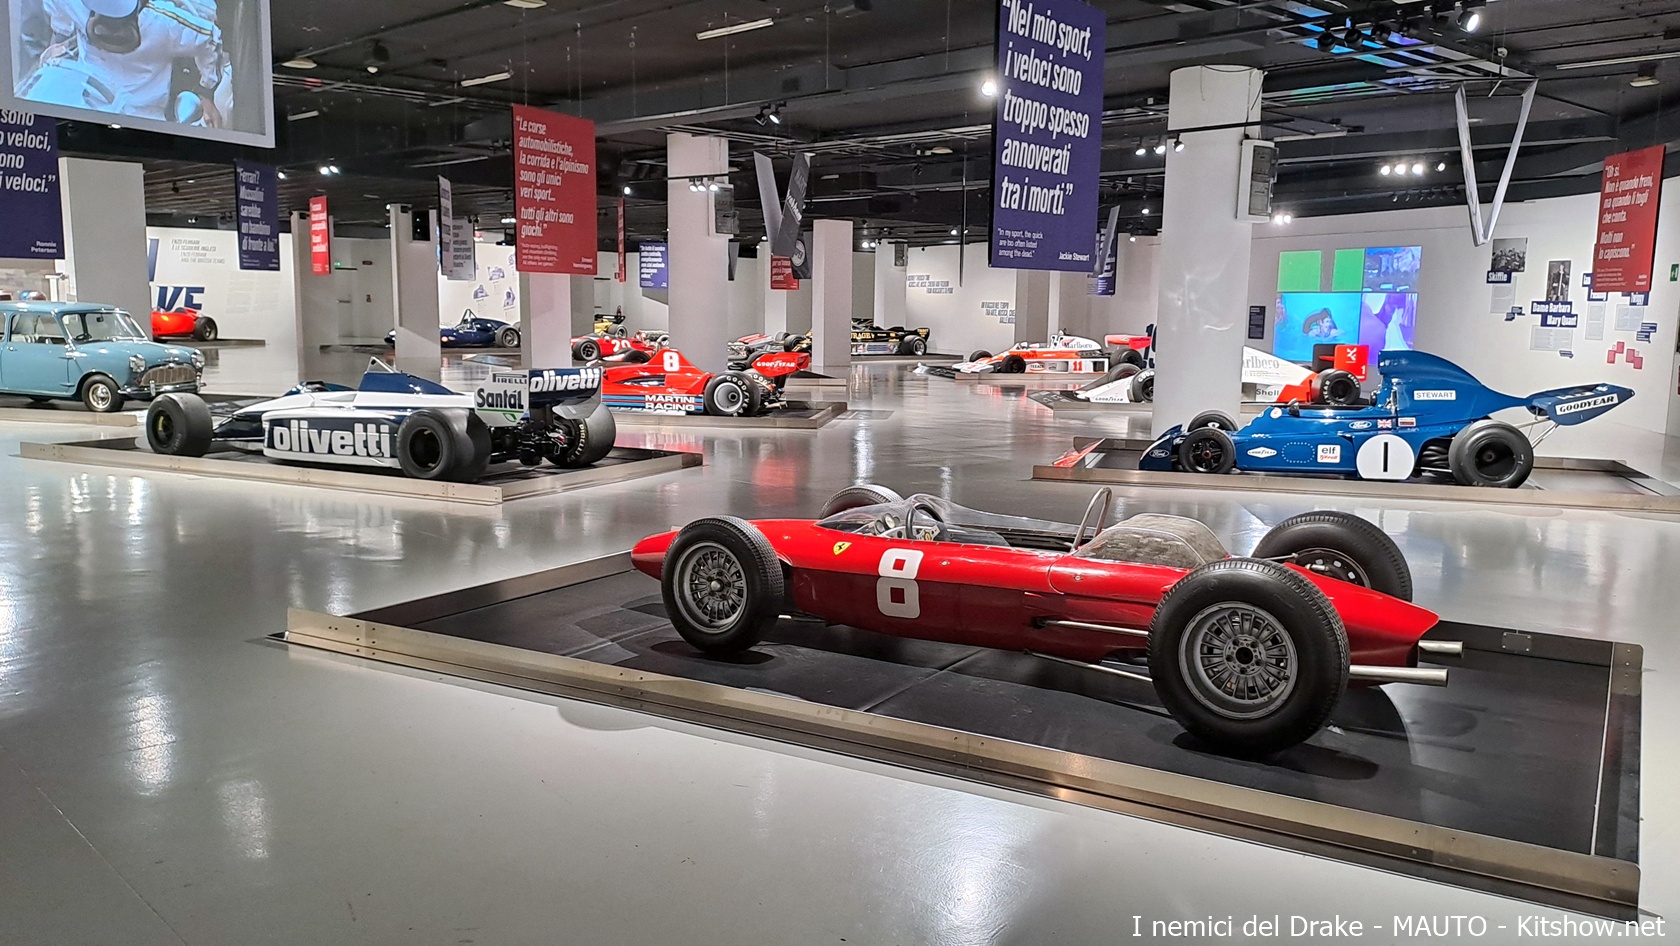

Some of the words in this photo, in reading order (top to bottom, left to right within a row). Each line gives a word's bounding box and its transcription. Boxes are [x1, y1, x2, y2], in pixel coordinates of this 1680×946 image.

[1032, 10, 1057, 46] mio
[1057, 22, 1091, 61] sport,
[1005, 41, 1013, 76] i
[1014, 48, 1053, 88] veloci
[1052, 64, 1082, 96] sono
[0, 110, 34, 126] sono
[1004, 88, 1048, 134] troppo
[1048, 106, 1090, 139] spesso
[528, 121, 547, 135] corse
[7, 130, 51, 152] veloci,
[519, 136, 573, 157] automobilistiche,
[519, 151, 526, 164] la
[527, 154, 550, 168] corrida
[551, 159, 555, 169] e
[556, 158, 589, 174] l'alpinismo
[1002, 138, 1071, 175] annoverati
[6, 173, 56, 193] veloci."
[520, 170, 536, 182] sono
[536, 170, 545, 186] gli
[546, 172, 562, 186] unici
[520, 184, 533, 198] veri
[1000, 176, 1020, 209] tra
[1021, 177, 1028, 210] i
[1028, 183, 1074, 215] morti."
[521, 206, 536, 219] tutti
[536, 207, 545, 222] gli
[545, 208, 559, 222] altri
[559, 213, 573, 224] sono
[1005, 230, 1011, 238] my
[1012, 230, 1024, 238] sport,
[1032, 231, 1043, 240] quick
[999, 250, 1013, 258] among
[1059, 252, 1072, 260] Jackie
[1073, 253, 1090, 261] Stewart
[1488, 272, 1507, 281] Skiffle
[1533, 303, 1548, 312] Dame
[1549, 303, 1570, 312] Barbara
[1547, 315, 1561, 327] Mary
[1562, 316, 1576, 325] Quant
[611, 340, 631, 352] 20
[663, 352, 680, 371] 8
[1073, 361, 1082, 371] 11
[1361, 365, 1366, 374] 1
[492, 373, 527, 384] PIRELLI
[530, 369, 600, 392] olivetti
[645, 395, 695, 403] MARTINI
[645, 403, 695, 411] RACING
[1560, 396, 1614, 412] GOODYEAR
[273, 420, 390, 458] olivetti
[1383, 441, 1388, 473] 1
[877, 548, 924, 618] 8
